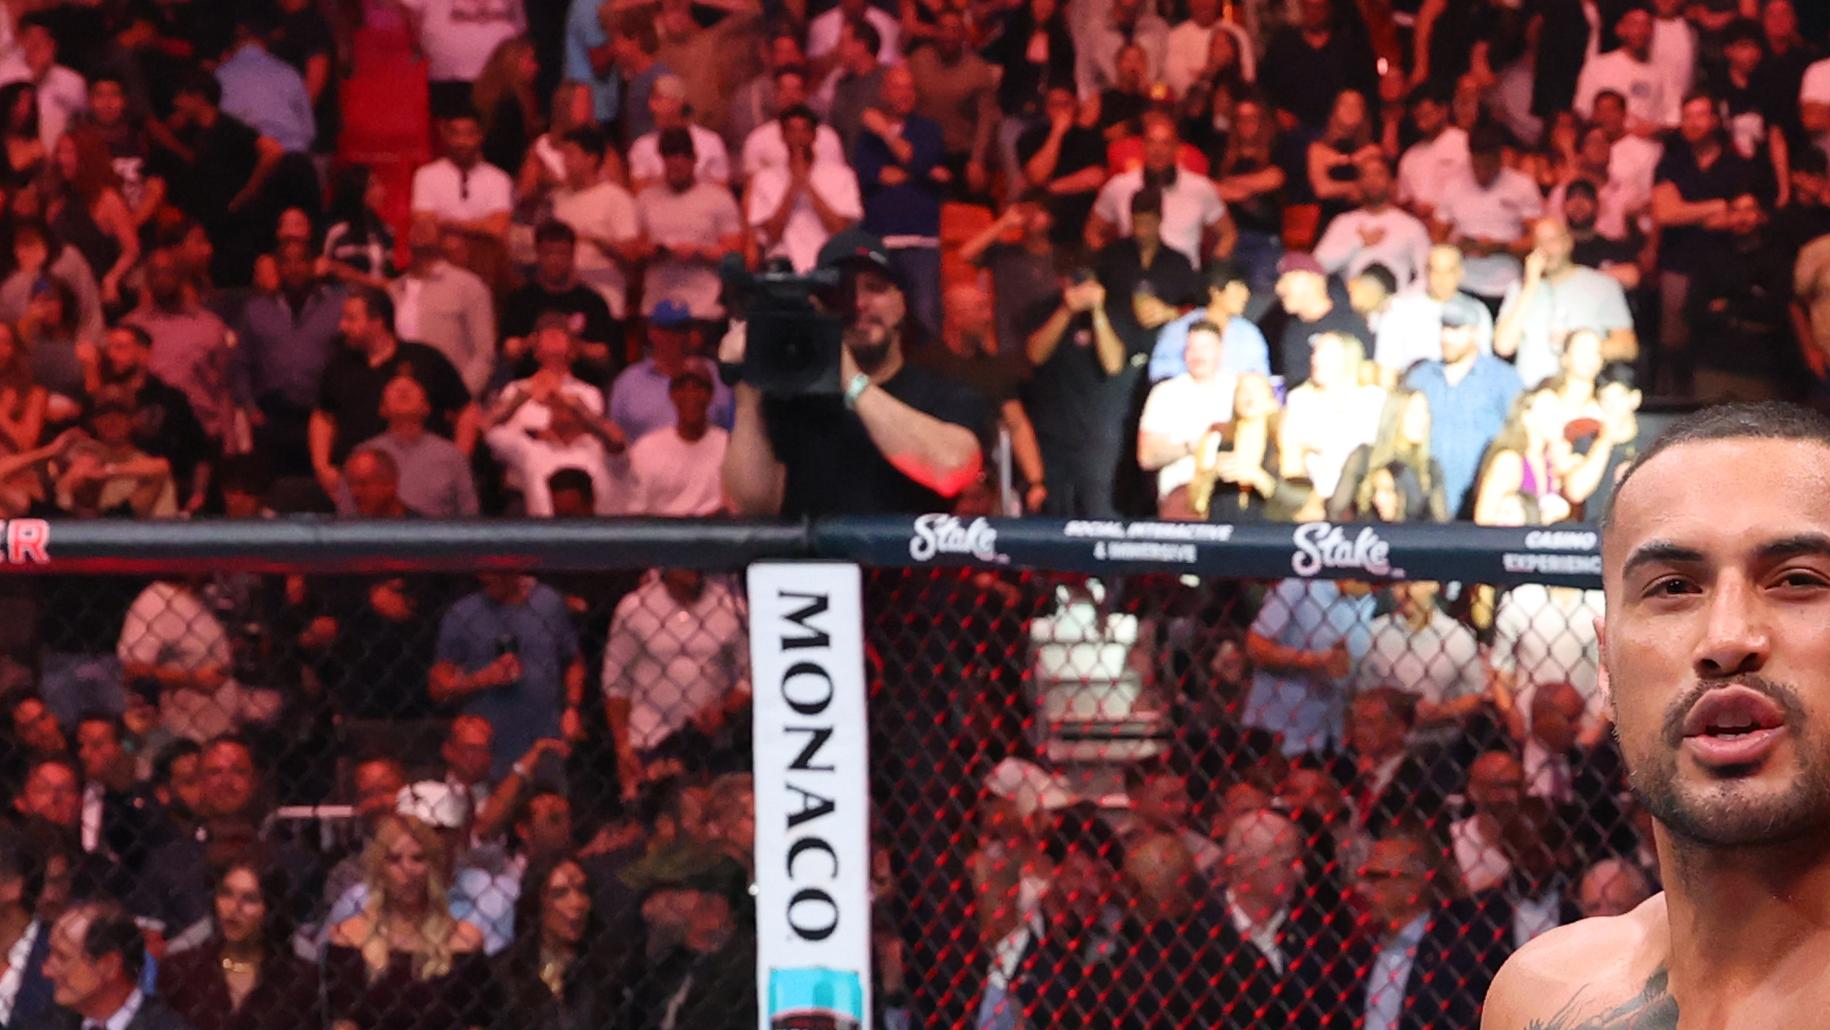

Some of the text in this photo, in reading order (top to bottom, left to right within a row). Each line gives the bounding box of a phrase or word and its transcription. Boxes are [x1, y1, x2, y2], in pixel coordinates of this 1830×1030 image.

[0, 519, 50, 565] R
[909, 513, 1010, 565] Stake
[1292, 521, 1405, 578] Stake
[1503, 553, 1602, 574] EXPERIENC
[1525, 531, 1598, 551] CASINO
[777, 589, 839, 942] MONACO
